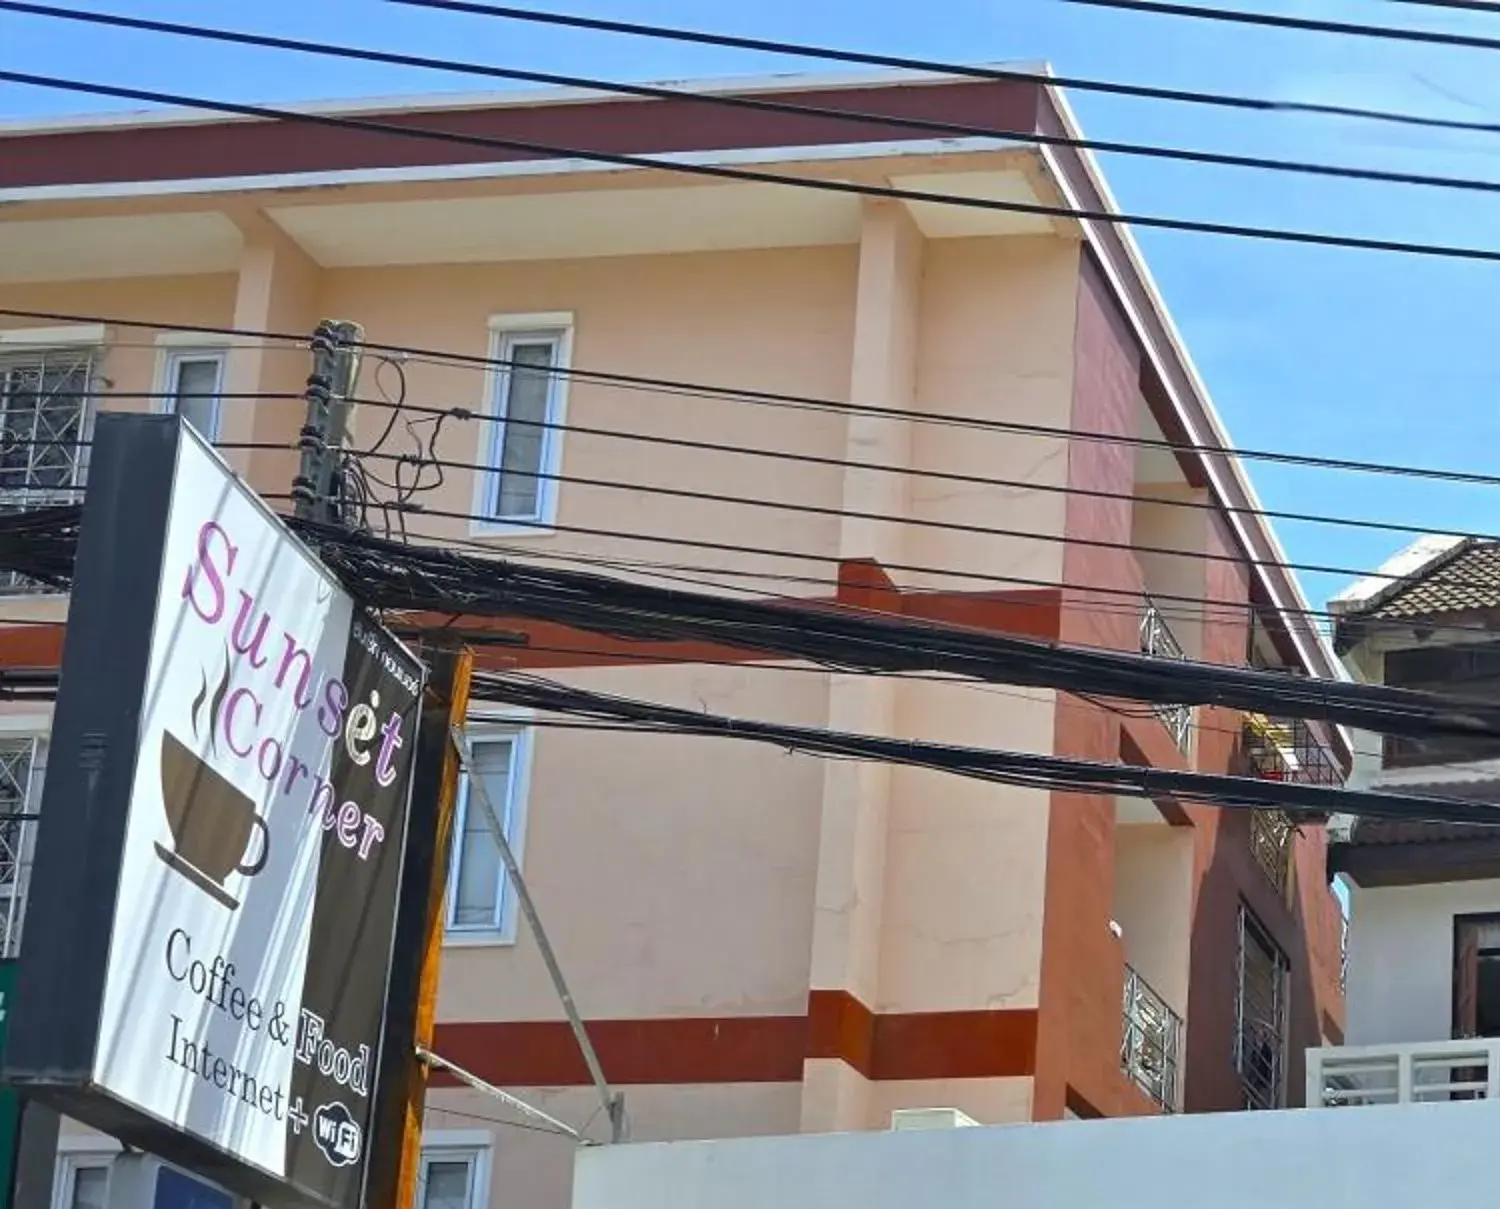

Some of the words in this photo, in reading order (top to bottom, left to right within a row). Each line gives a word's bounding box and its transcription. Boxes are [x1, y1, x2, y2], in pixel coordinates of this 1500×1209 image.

[182, 521, 402, 787] Sunset
[223, 688, 384, 860] Corner
[166, 928, 262, 1031] Coffee
[268, 1001, 290, 1046] &
[296, 1008, 370, 1096] Food
[166, 1014, 284, 1121] Internet
